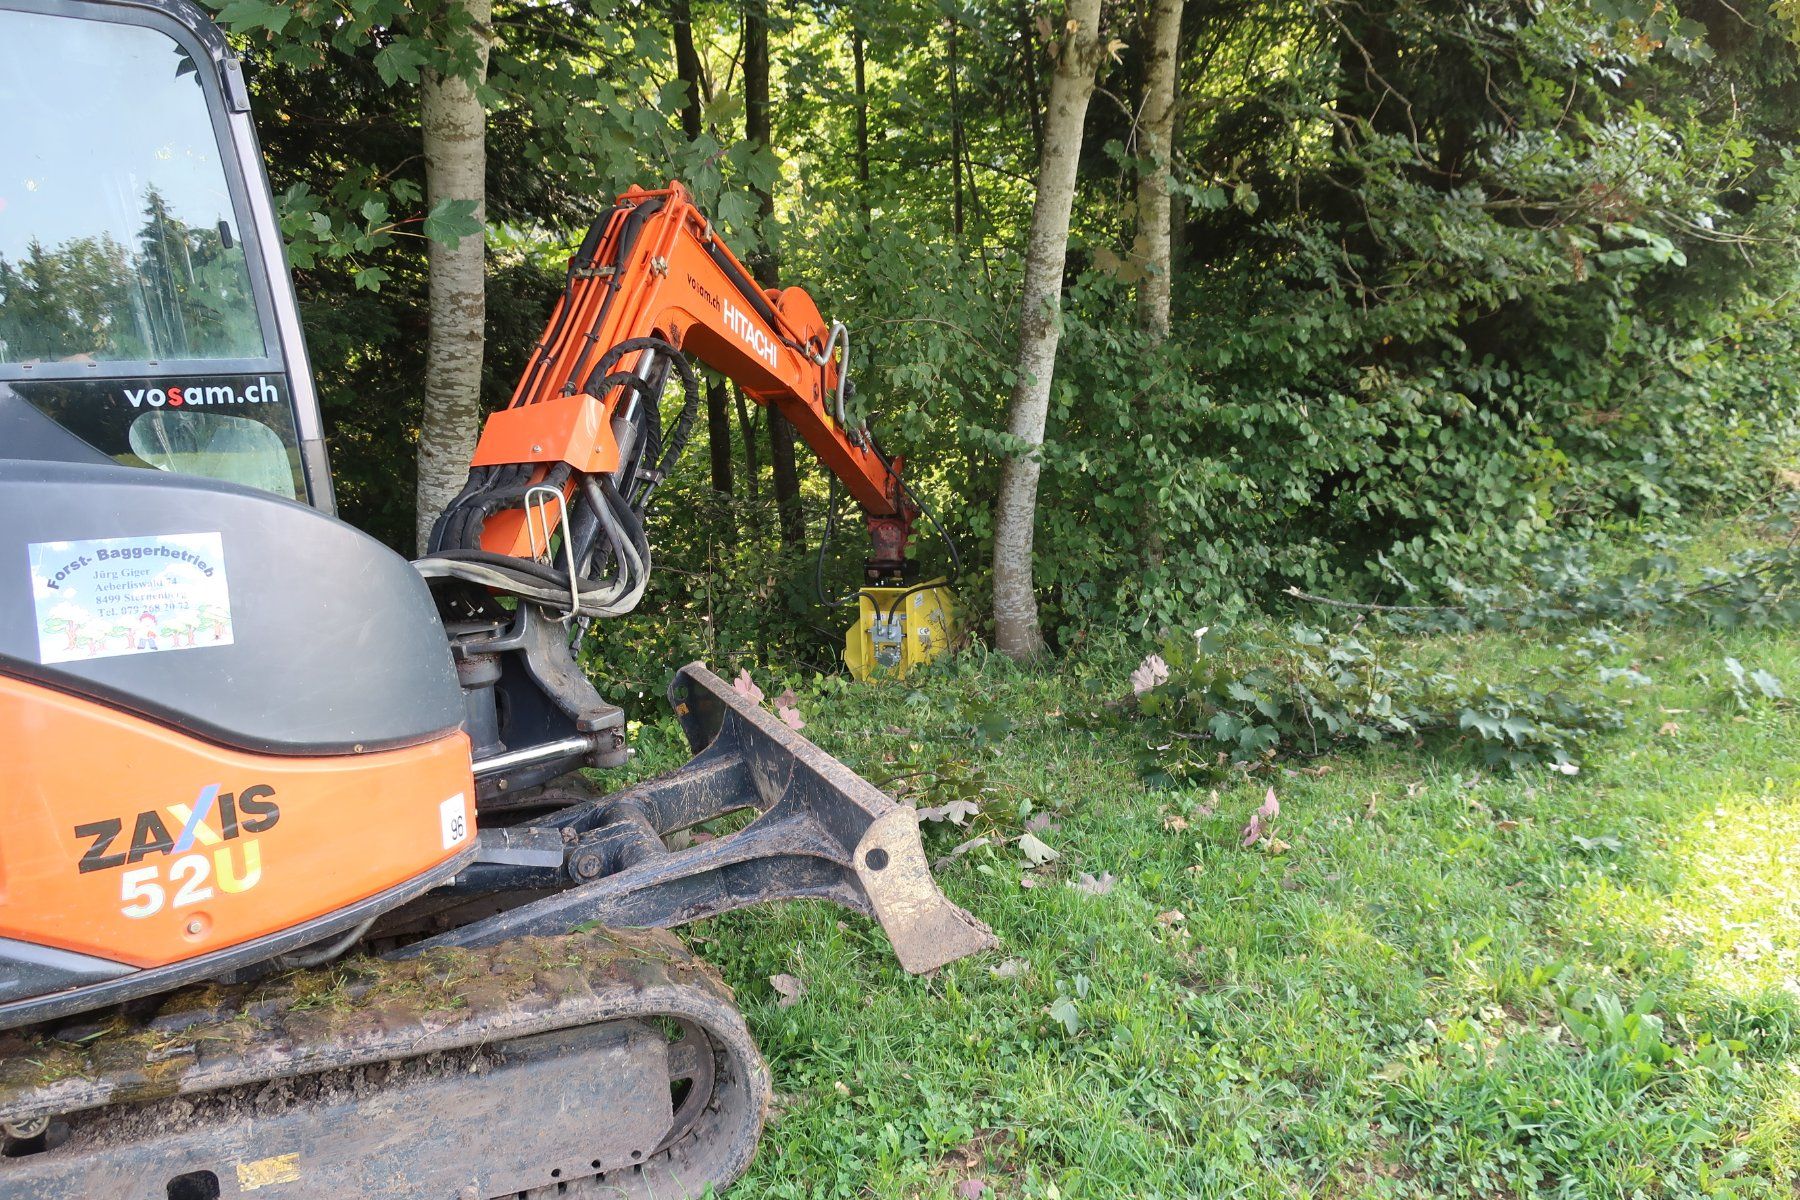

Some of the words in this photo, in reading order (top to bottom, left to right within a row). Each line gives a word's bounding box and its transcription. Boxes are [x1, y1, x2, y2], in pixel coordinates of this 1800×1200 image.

[687, 273, 721, 312] vosam.ch
[723, 298, 777, 369] HITACHI
[123, 377, 279, 408] vosam.ch
[47, 556, 93, 590] Forst-
[96, 545, 214, 578] Baggerbetrieb
[93, 570, 119, 580] Jürg
[120, 568, 150, 577] Giger
[96, 595, 121, 605] 8499
[98, 608, 118, 617] Tel.
[121, 605, 139, 615] 079
[74, 784, 280, 874] ZAXIS
[451, 815, 463, 840] 96
[120, 840, 262, 919] 52U
